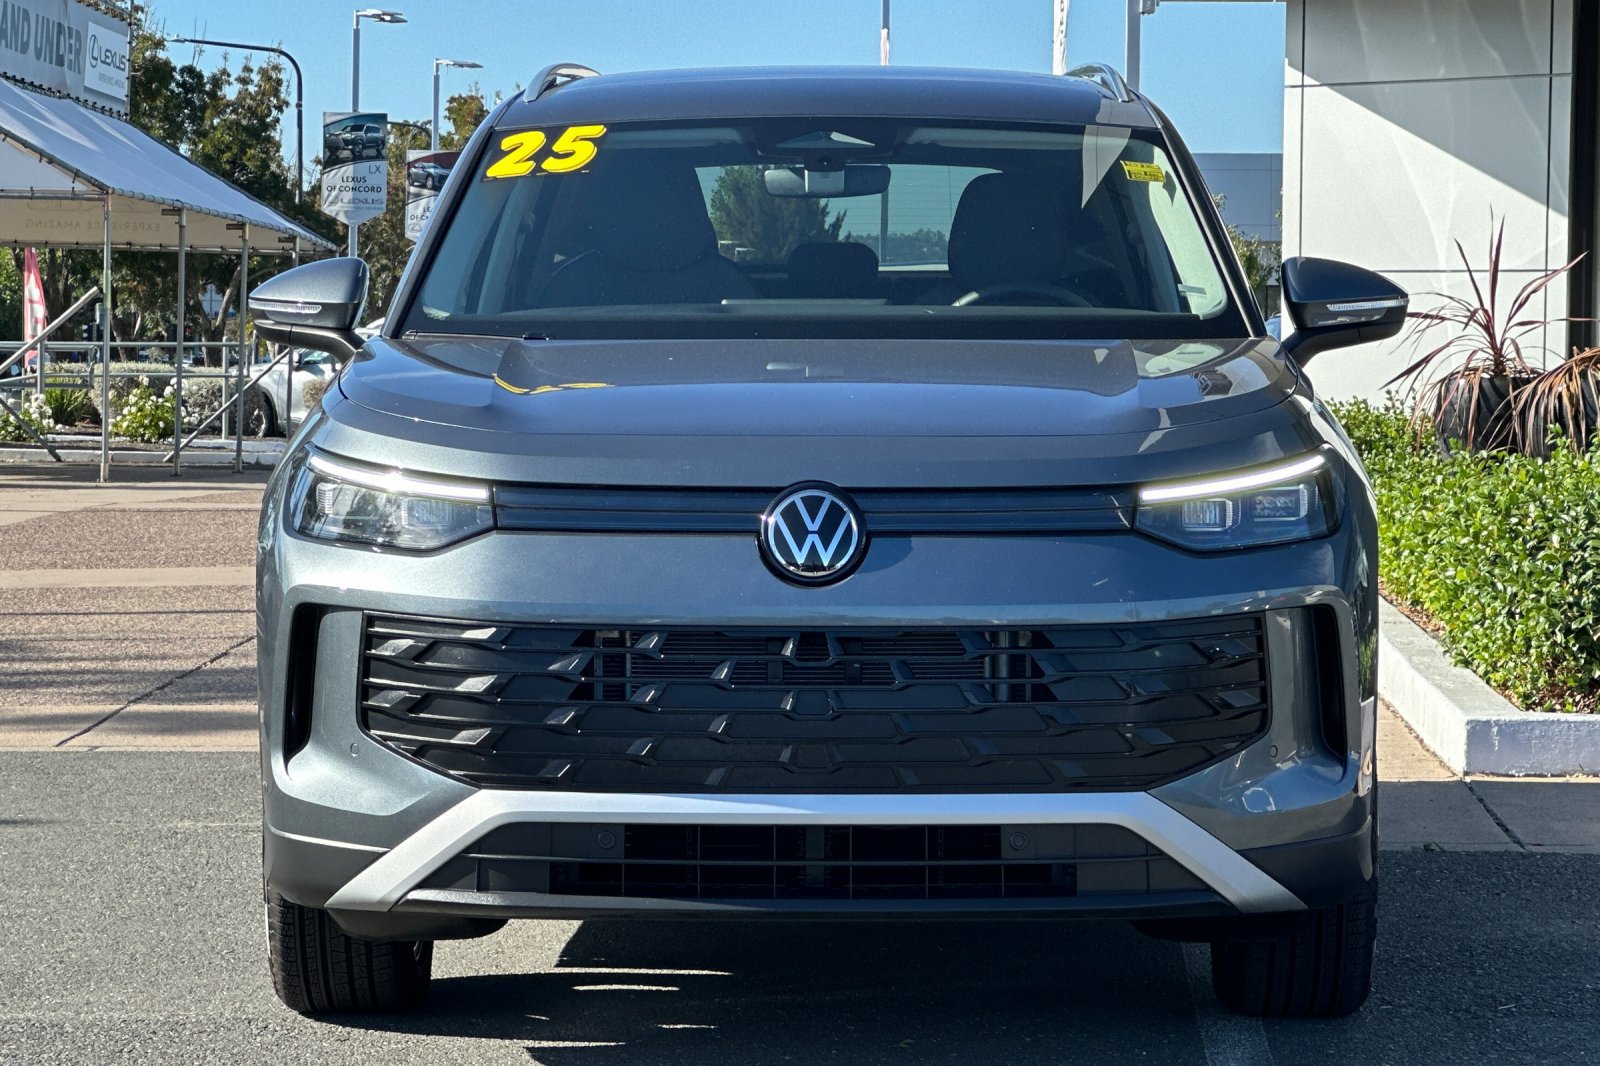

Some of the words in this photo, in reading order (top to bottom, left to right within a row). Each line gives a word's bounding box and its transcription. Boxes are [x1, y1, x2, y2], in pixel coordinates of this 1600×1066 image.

[0, 0, 31, 55] AND
[34, 13, 82, 75] UNDER
[100, 45, 127, 72] LEXUS
[486, 125, 607, 178] 25
[368, 165, 382, 174] LX
[338, 185, 382, 193] CONCORD
[341, 176, 367, 184] LEXUS
